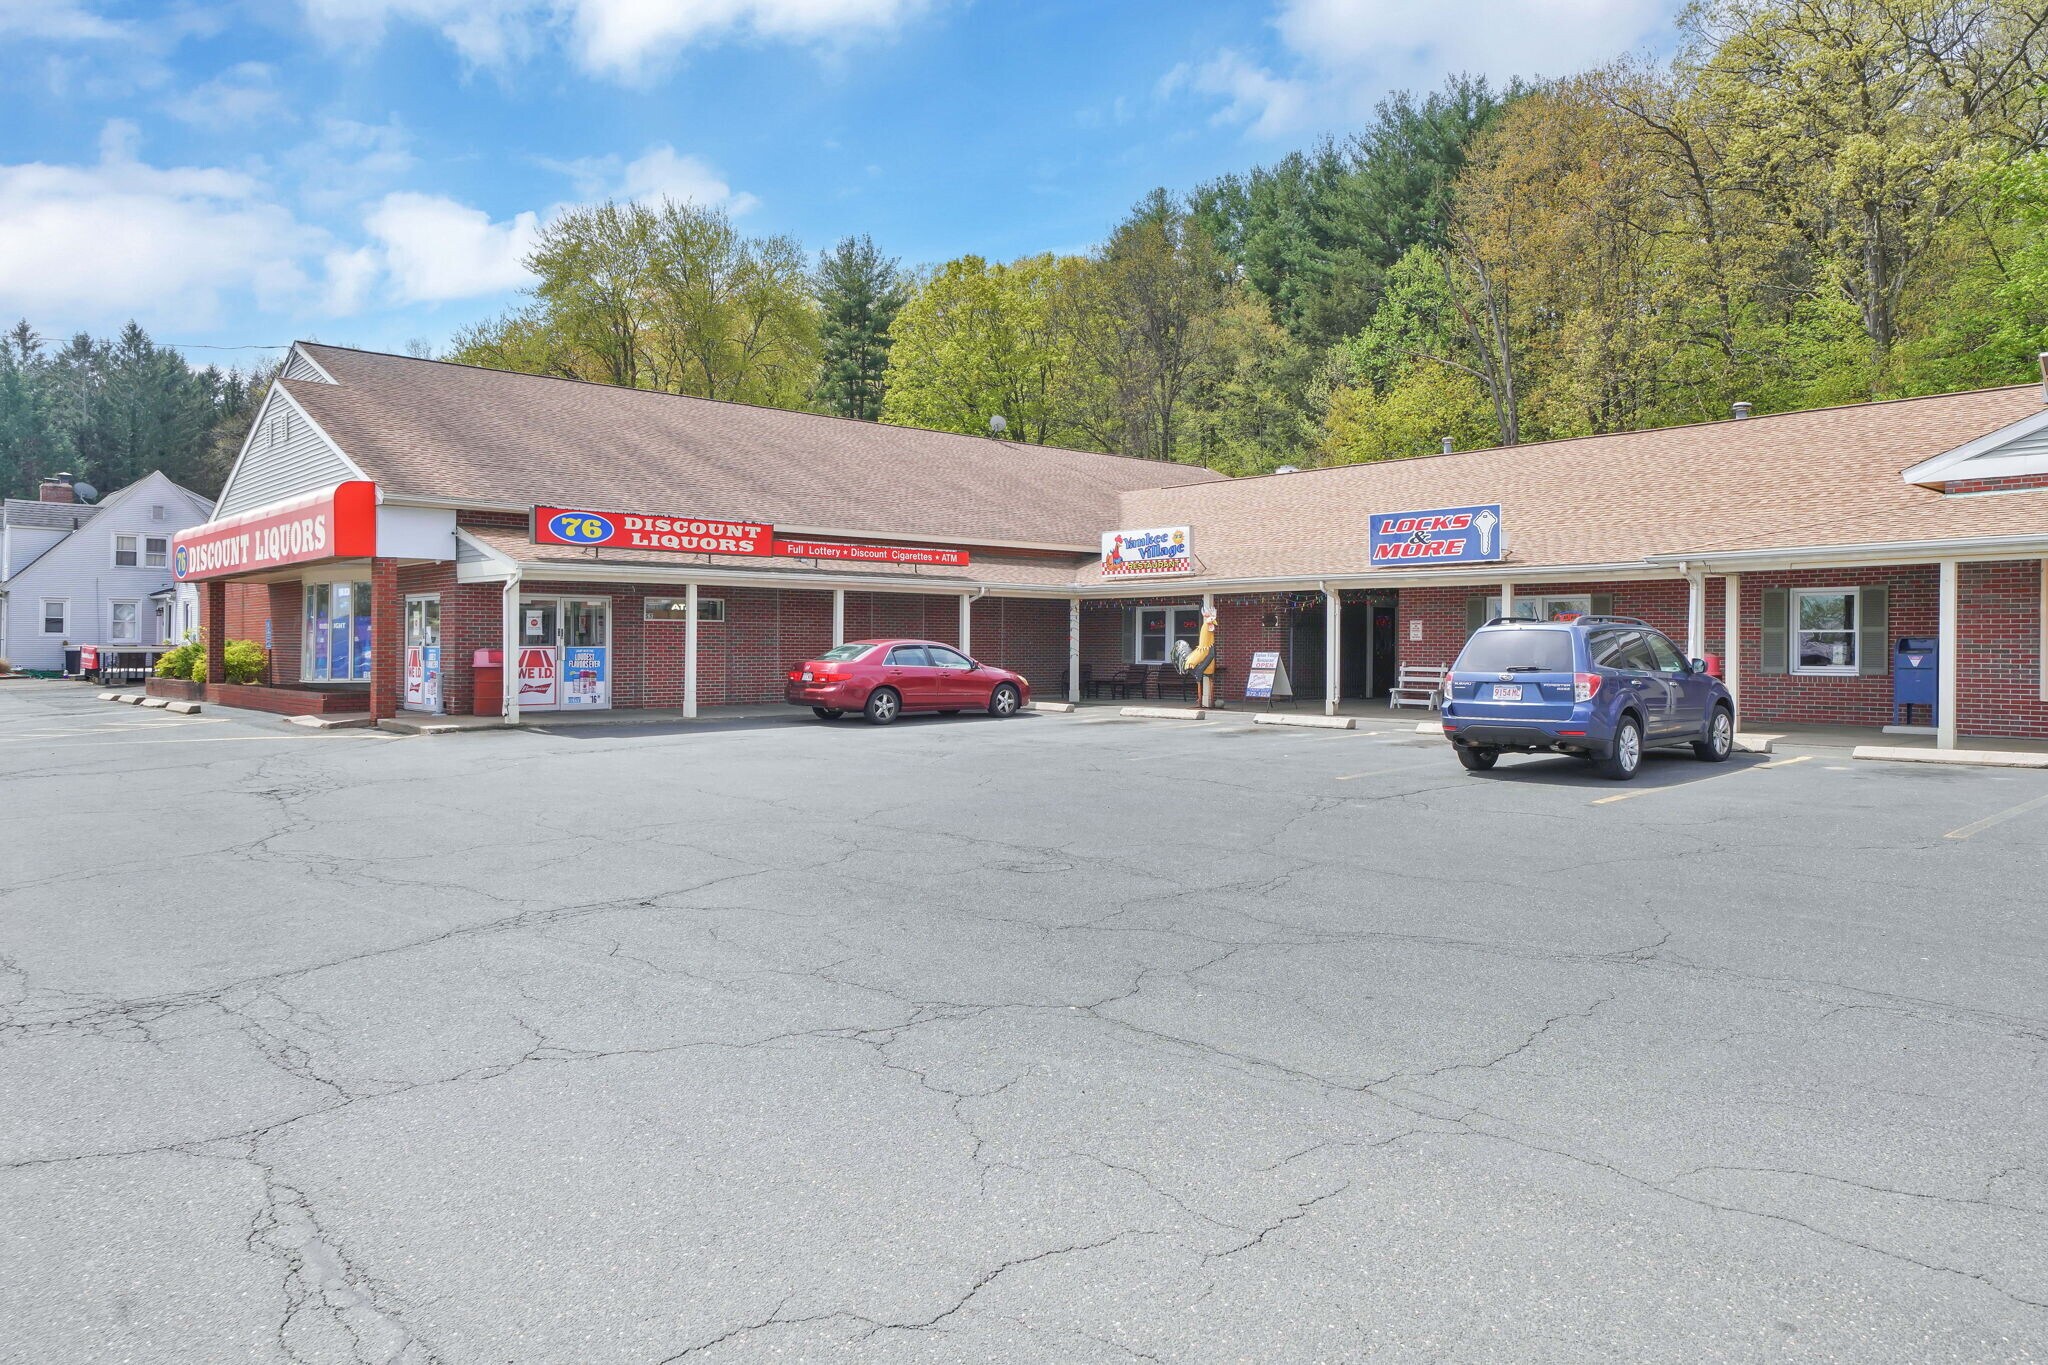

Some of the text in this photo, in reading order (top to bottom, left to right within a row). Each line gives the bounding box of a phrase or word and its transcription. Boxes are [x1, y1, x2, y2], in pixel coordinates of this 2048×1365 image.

[561, 517, 603, 538] 76
[624, 516, 761, 539] DISCOUNT
[1379, 513, 1472, 534] LOCKS
[176, 514, 326, 573] 76 DISCOUNT LIQUORS
[631, 532, 755, 552] LIQUORS
[1123, 532, 1169, 549] Yankee
[1408, 530, 1432, 545] &
[787, 544, 958, 562] Full Lottery Discount Cigarettes ATM
[1138, 543, 1185, 559] Village
[1373, 538, 1466, 560] MORE
[1128, 560, 1181, 570] RESTAURANT
[671, 603, 687, 611] AT
[518, 667, 554, 679] WE I.D.
